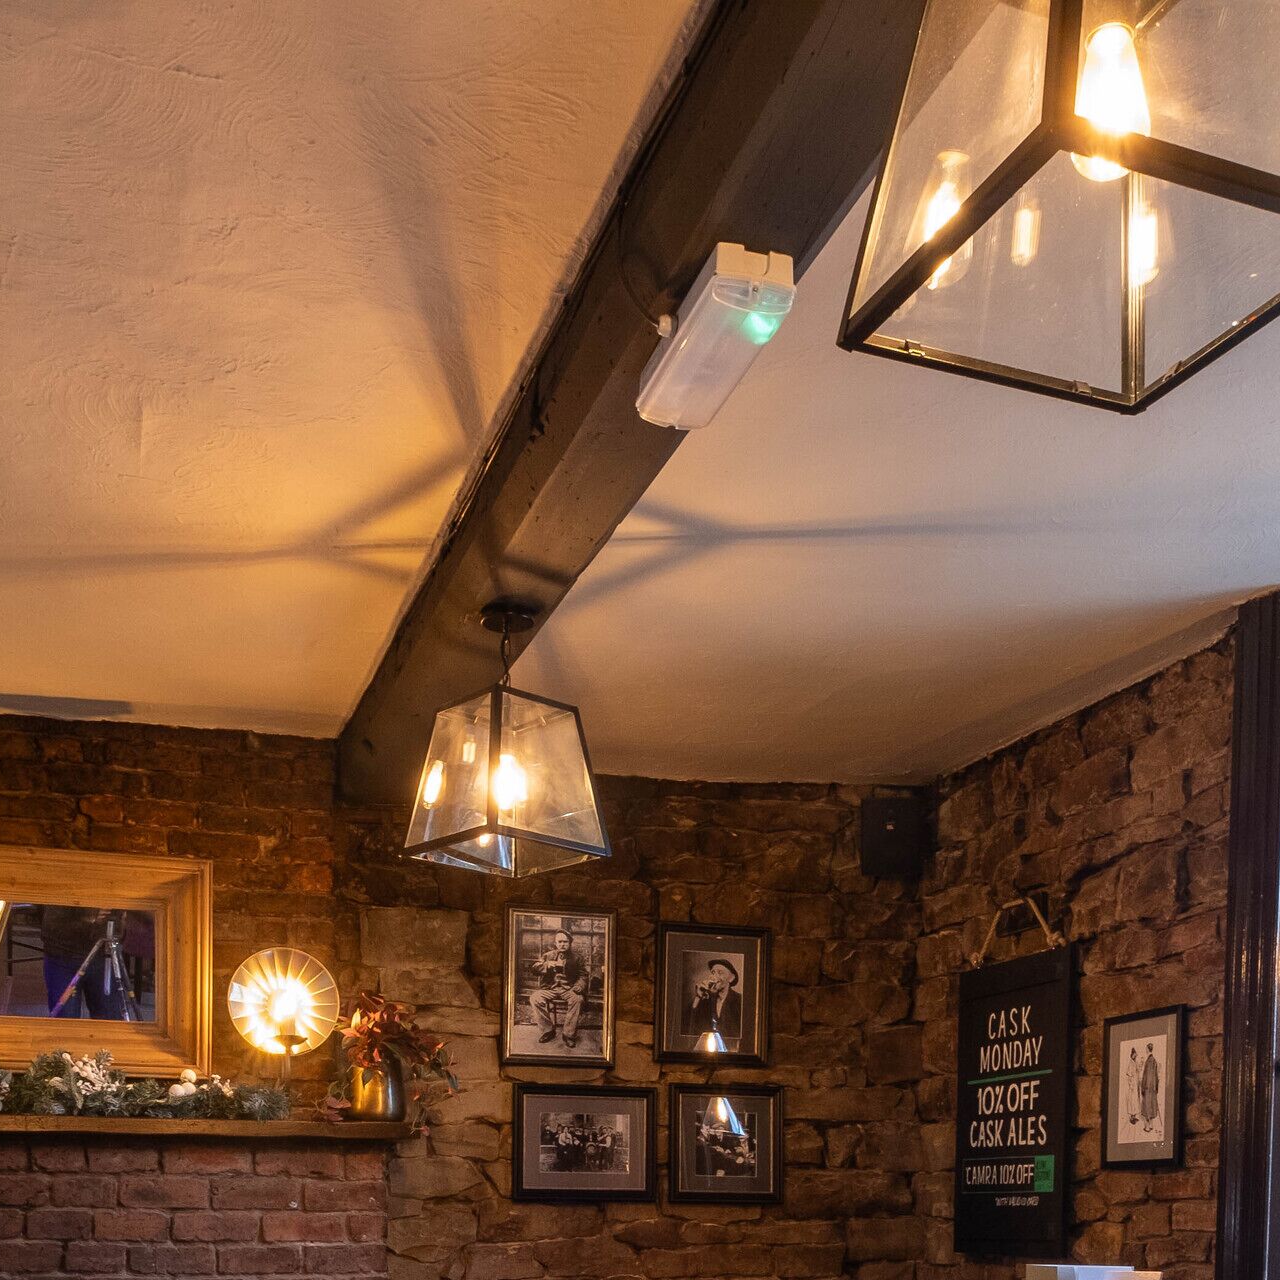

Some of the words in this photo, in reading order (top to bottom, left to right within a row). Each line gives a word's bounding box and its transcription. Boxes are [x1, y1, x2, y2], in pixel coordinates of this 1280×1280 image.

[988, 1005, 1031, 1039] CASK
[980, 1036, 1043, 1074] MONDAY
[977, 1085, 1004, 1115] 10%
[1007, 1080, 1040, 1112] OFF
[970, 1119, 1003, 1148] CASK
[1007, 1114, 1047, 1146] ALES
[1000, 1164, 1016, 1185] 10%
[1016, 1164, 1034, 1185] OFF
